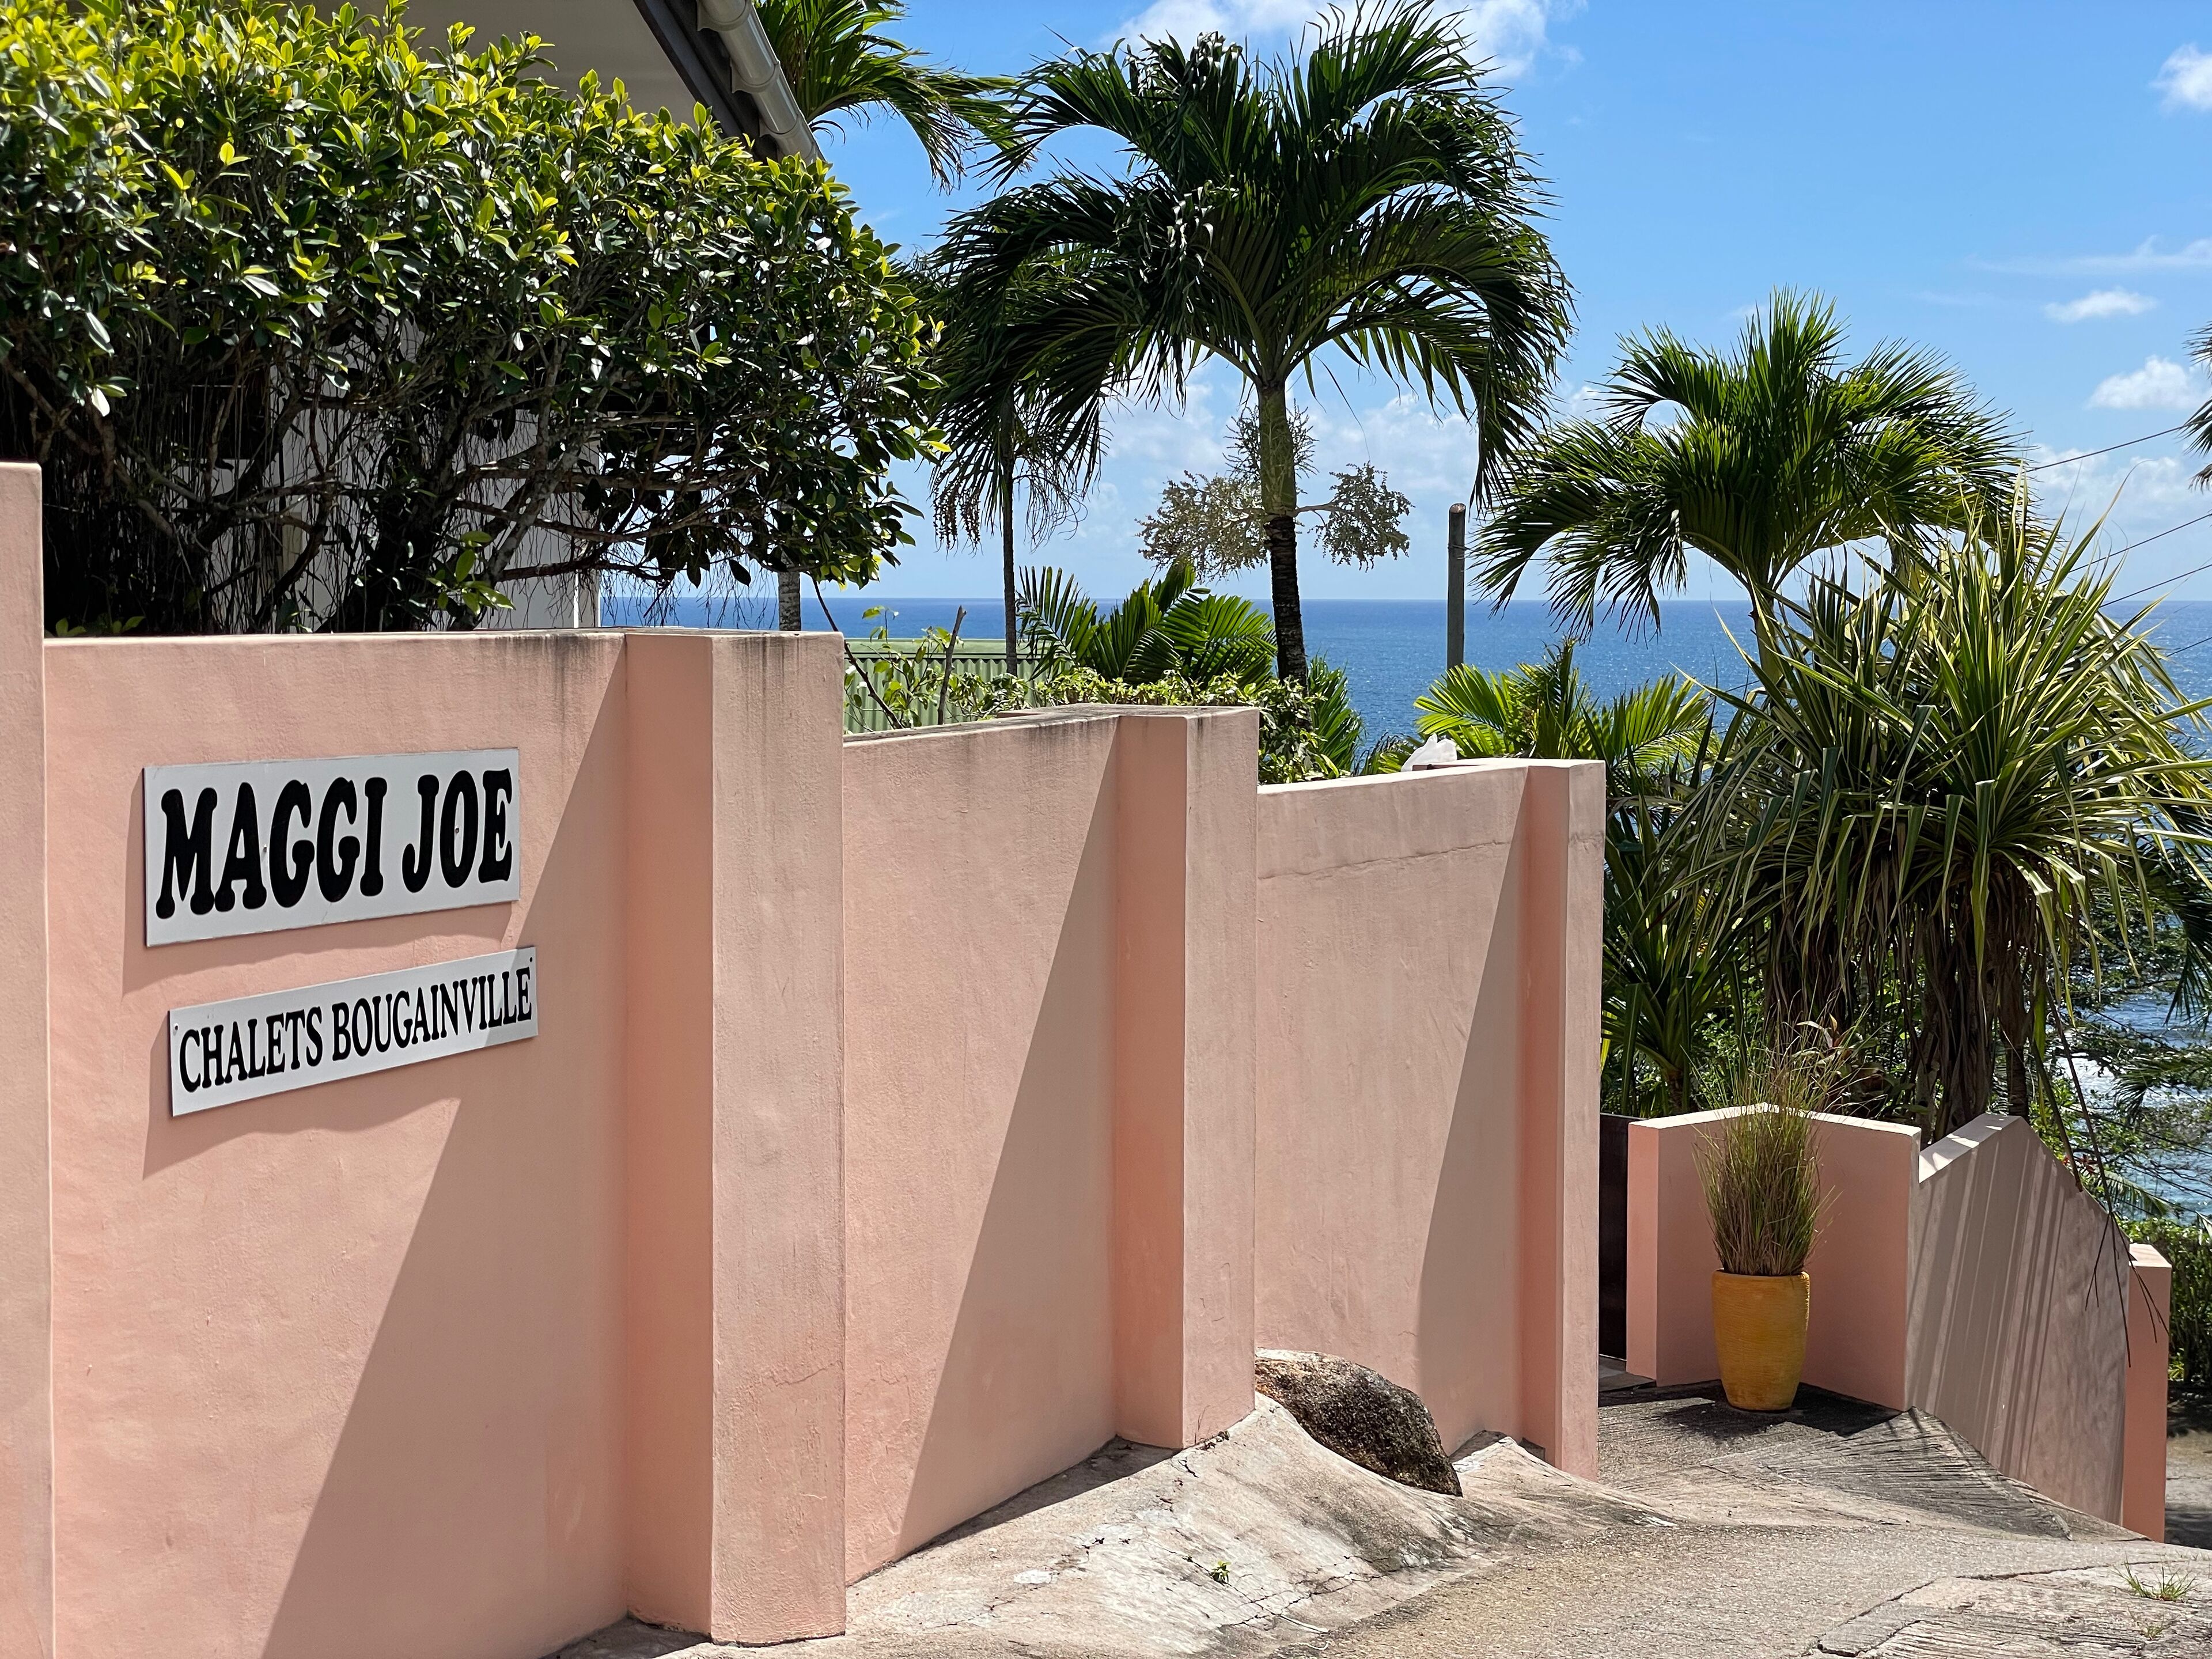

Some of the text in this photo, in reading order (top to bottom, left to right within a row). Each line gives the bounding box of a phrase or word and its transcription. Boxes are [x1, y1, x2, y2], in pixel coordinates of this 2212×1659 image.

[156, 768, 512, 919] MAGGI JOE
[179, 966, 532, 1093] CHALETS BOUGAINVILLE
